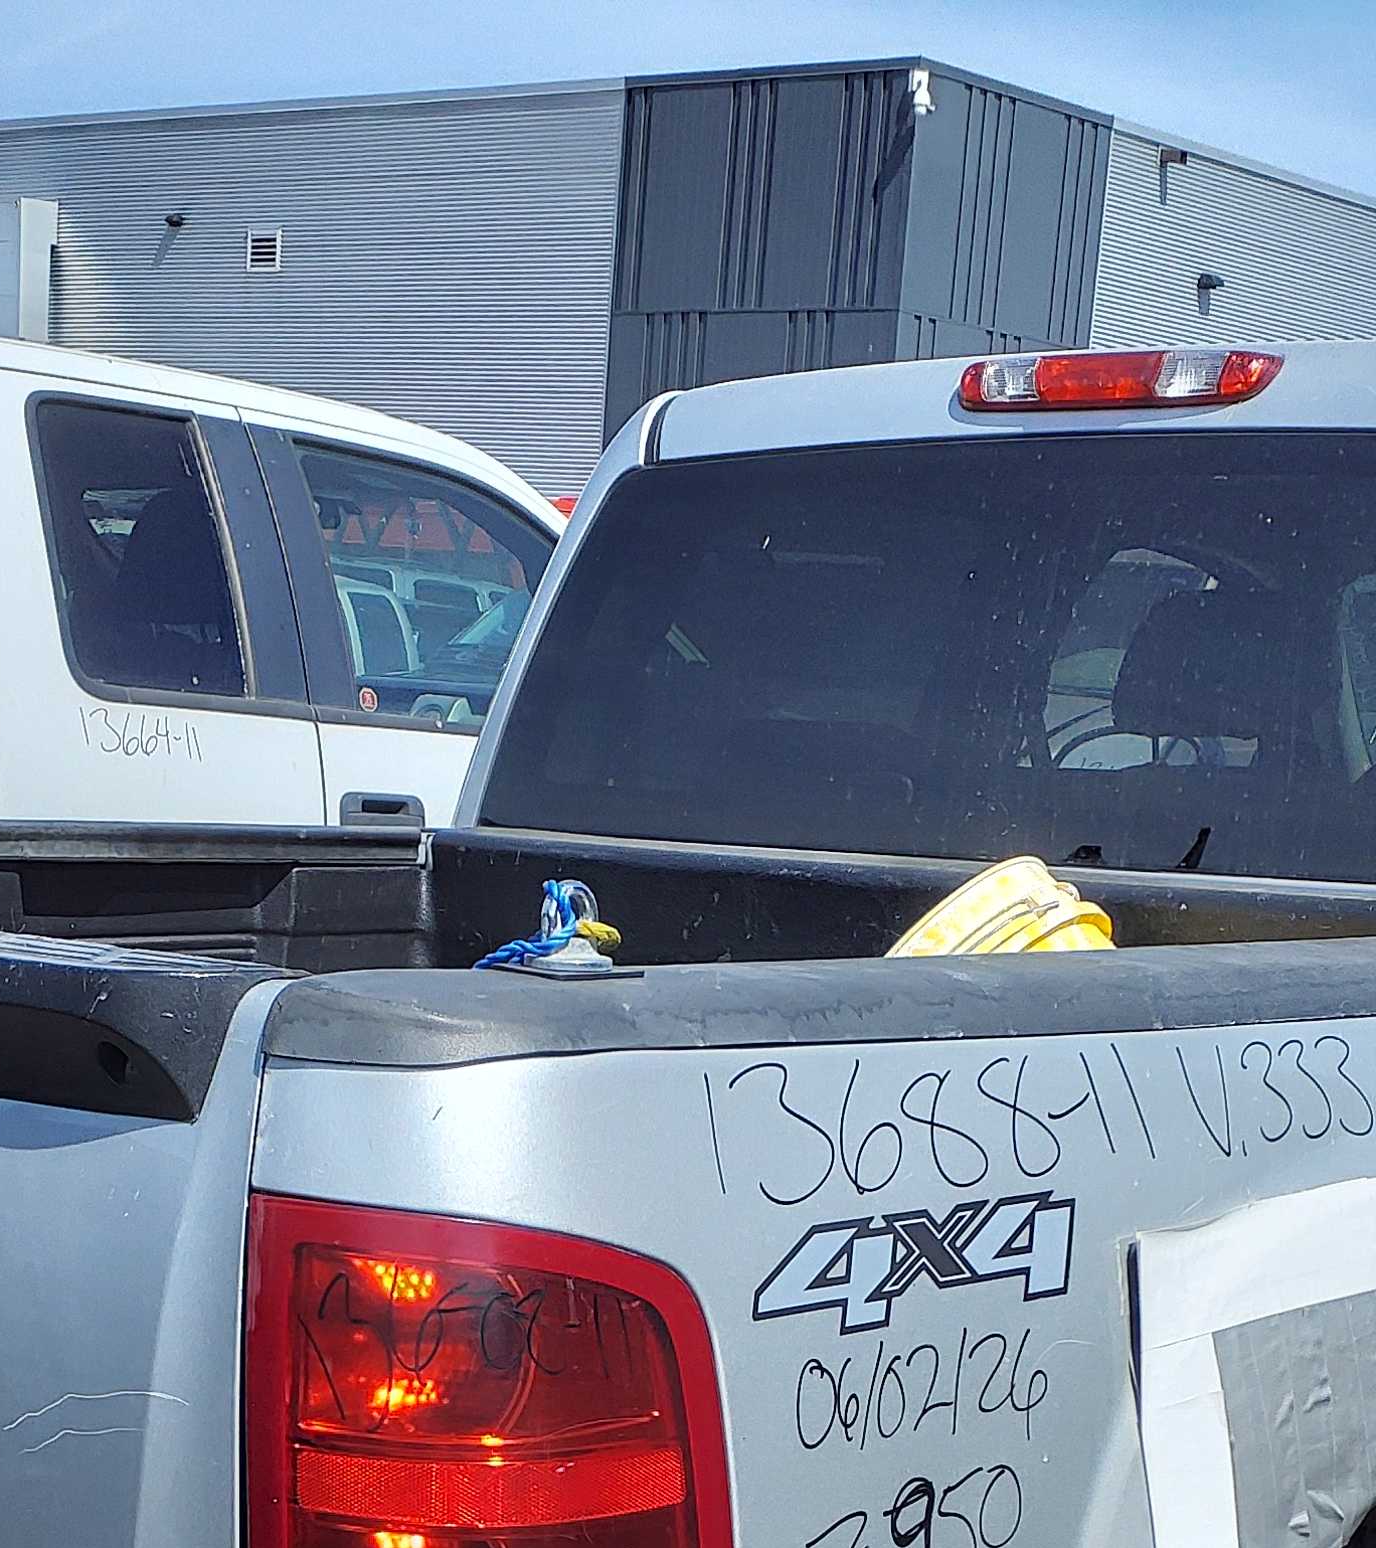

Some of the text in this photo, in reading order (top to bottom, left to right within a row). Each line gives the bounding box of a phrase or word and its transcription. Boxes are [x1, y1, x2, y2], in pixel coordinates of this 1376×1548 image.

[79, 706, 202, 762] 13664-11
[703, 1043, 1156, 1206] 13688-11
[796, 1327, 1049, 1450] 06/02/26
